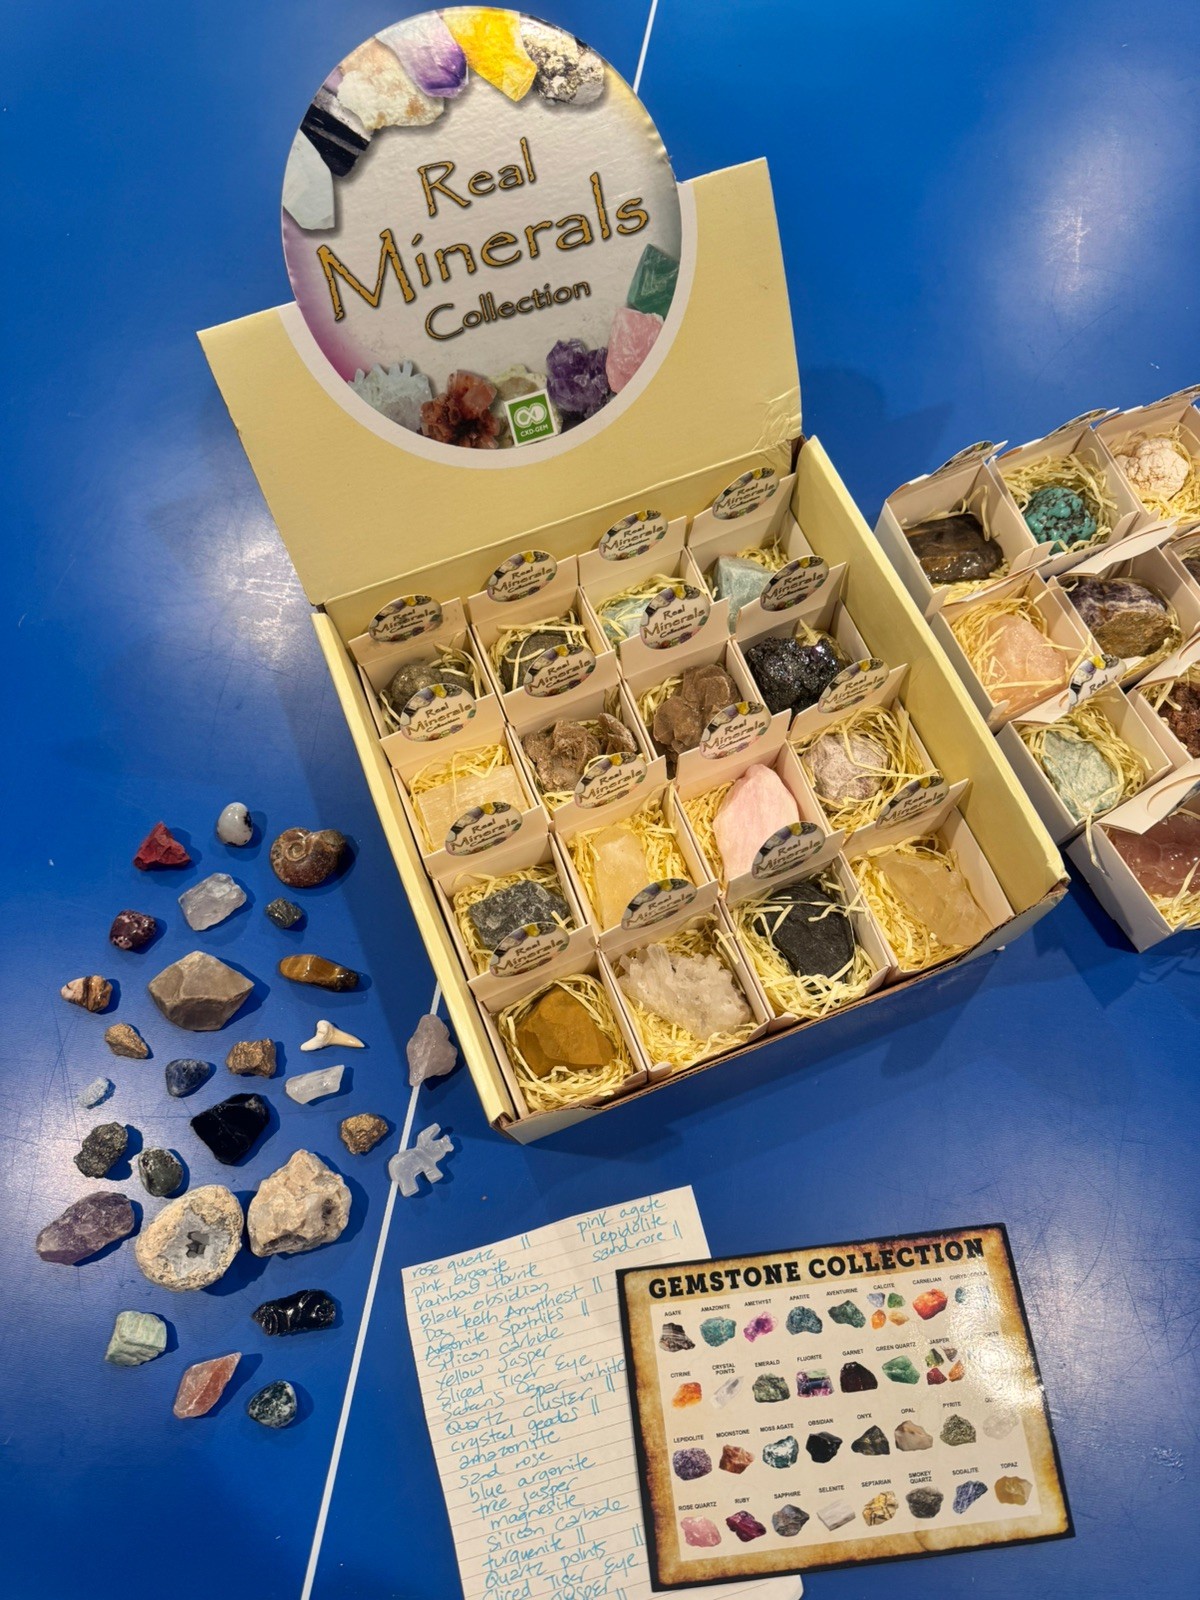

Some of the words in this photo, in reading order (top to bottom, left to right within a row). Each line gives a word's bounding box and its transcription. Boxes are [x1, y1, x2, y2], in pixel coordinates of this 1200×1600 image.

[418, 137, 538, 218] Real
[316, 172, 650, 322] Minerals
[424, 280, 592, 340] Collection
[521, 424, 549, 437] CXD-GEM
[737, 483, 758, 496] Real
[716, 484, 775, 512] Minerals
[603, 526, 663, 552] Minerals
[624, 525, 644, 538] Real
[512, 566, 533, 580] Real
[784, 572, 806, 585] Real
[492, 567, 552, 595] Minerals
[763, 573, 824, 603] Minerals
[393, 609, 415, 621] Real
[663, 605, 685, 620] Real
[373, 609, 436, 636] Minerals
[644, 607, 705, 638] Minerals
[548, 660, 570, 675] Real
[529, 660, 591, 692] Minerals
[845, 676, 866, 690] Real
[425, 702, 449, 718] Real
[406, 703, 472, 735] Minerals
[725, 720, 746, 735] Real
[703, 721, 765, 752] Minerals
[600, 770, 622, 785] Real
[579, 770, 642, 803] Minerals
[904, 792, 926, 807] Real
[472, 818, 496, 834] Real
[451, 819, 518, 850] Minerals
[778, 840, 801, 856] Real
[757, 840, 820, 874] Minerals
[648, 895, 671, 910] Real
[515, 940, 540, 956] Real
[494, 939, 564, 974] Minerals
[577, 1211, 613, 1242] pink
[620, 1195, 666, 1220] agate
[636, 1232, 666, 1247] rose
[412, 1264, 440, 1278] rose
[649, 1262, 800, 1298] GEMSTONE
[809, 1238, 985, 1278] COLLECTION
[912, 1277, 942, 1285] CARNELIAN
[411, 1279, 445, 1304] pink
[826, 1288, 858, 1296] AVENTURINE
[421, 1306, 466, 1328] Black
[473, 1282, 549, 1310] obsidian
[701, 1304, 730, 1312] AMAZONITE
[895, 1342, 916, 1350] QUARTZ
[929, 1337, 950, 1345] JASPER
[498, 1344, 552, 1373] Jasper
[797, 1354, 822, 1362] FLUORITE
[712, 1362, 735, 1370] CRYSTAL
[437, 1379, 484, 1407] Sliced
[555, 1354, 592, 1375] Eye
[808, 1418, 833, 1426] OBSIDIAN
[673, 1435, 704, 1443] LEPIDOLITE
[716, 1429, 750, 1438] MOONSTONE
[516, 1452, 553, 1468] rose
[908, 1470, 931, 1478] SMOKEY
[952, 1467, 979, 1476] SODALITE
[861, 1479, 891, 1487] SEPTARIAN
[910, 1476, 932, 1484] QUARTZ
[470, 1483, 506, 1504] blue
[774, 1491, 801, 1500] SAPPHIRE
[818, 1485, 845, 1493] SELENITE
[472, 1498, 512, 1520] tree
[694, 1501, 717, 1510] QUARTZ
[604, 1553, 638, 1577] Eye
